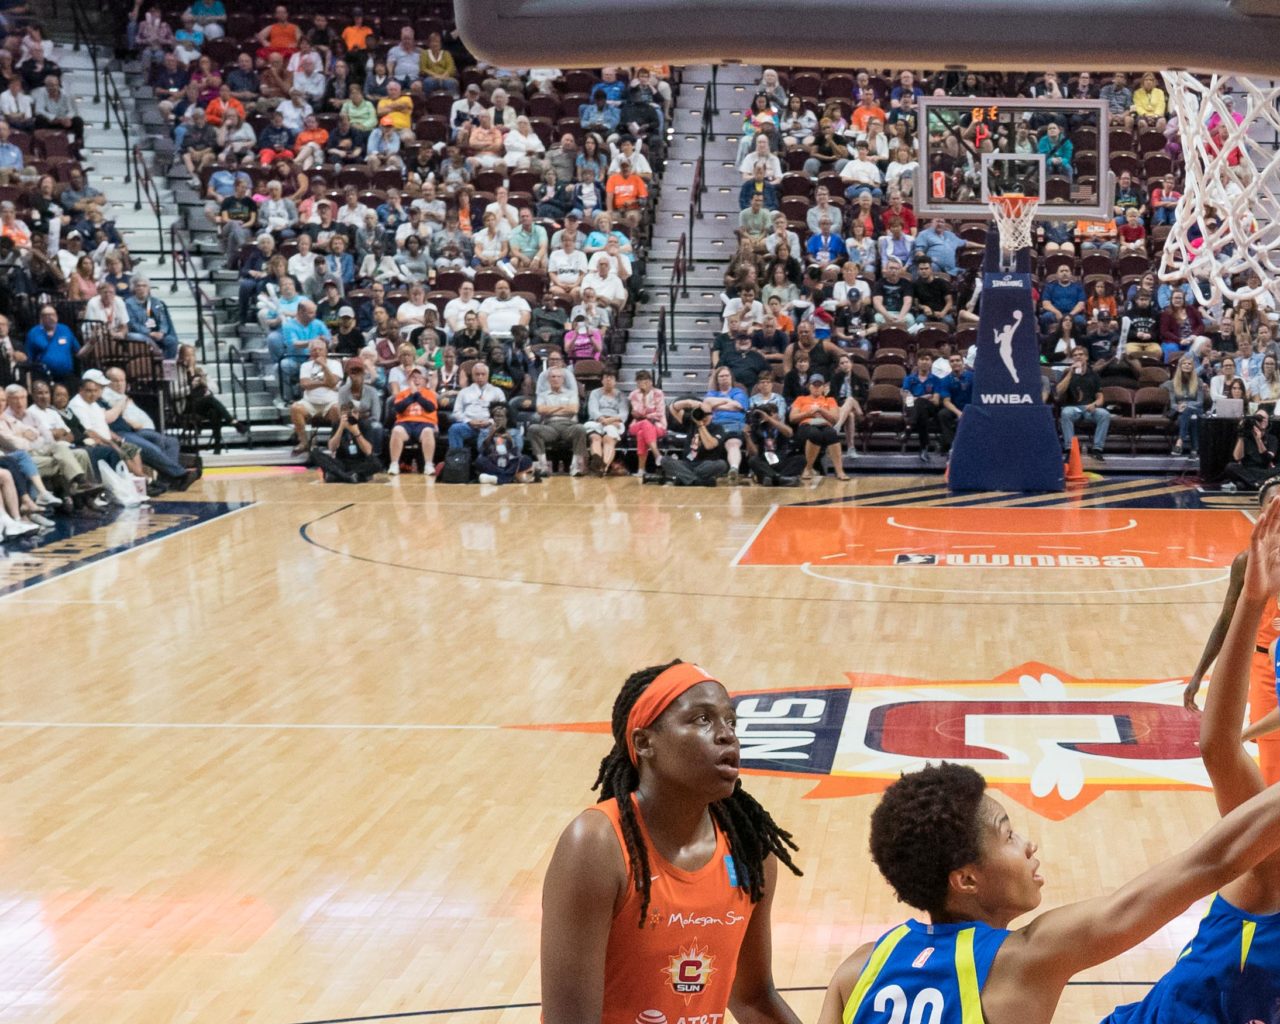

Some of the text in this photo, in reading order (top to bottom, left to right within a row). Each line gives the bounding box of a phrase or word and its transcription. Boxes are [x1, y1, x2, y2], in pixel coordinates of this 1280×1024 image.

[980, 394, 1033, 404] WNBA
[667, 912, 724, 928] Mohegan
[676, 984, 701, 992] SUN
